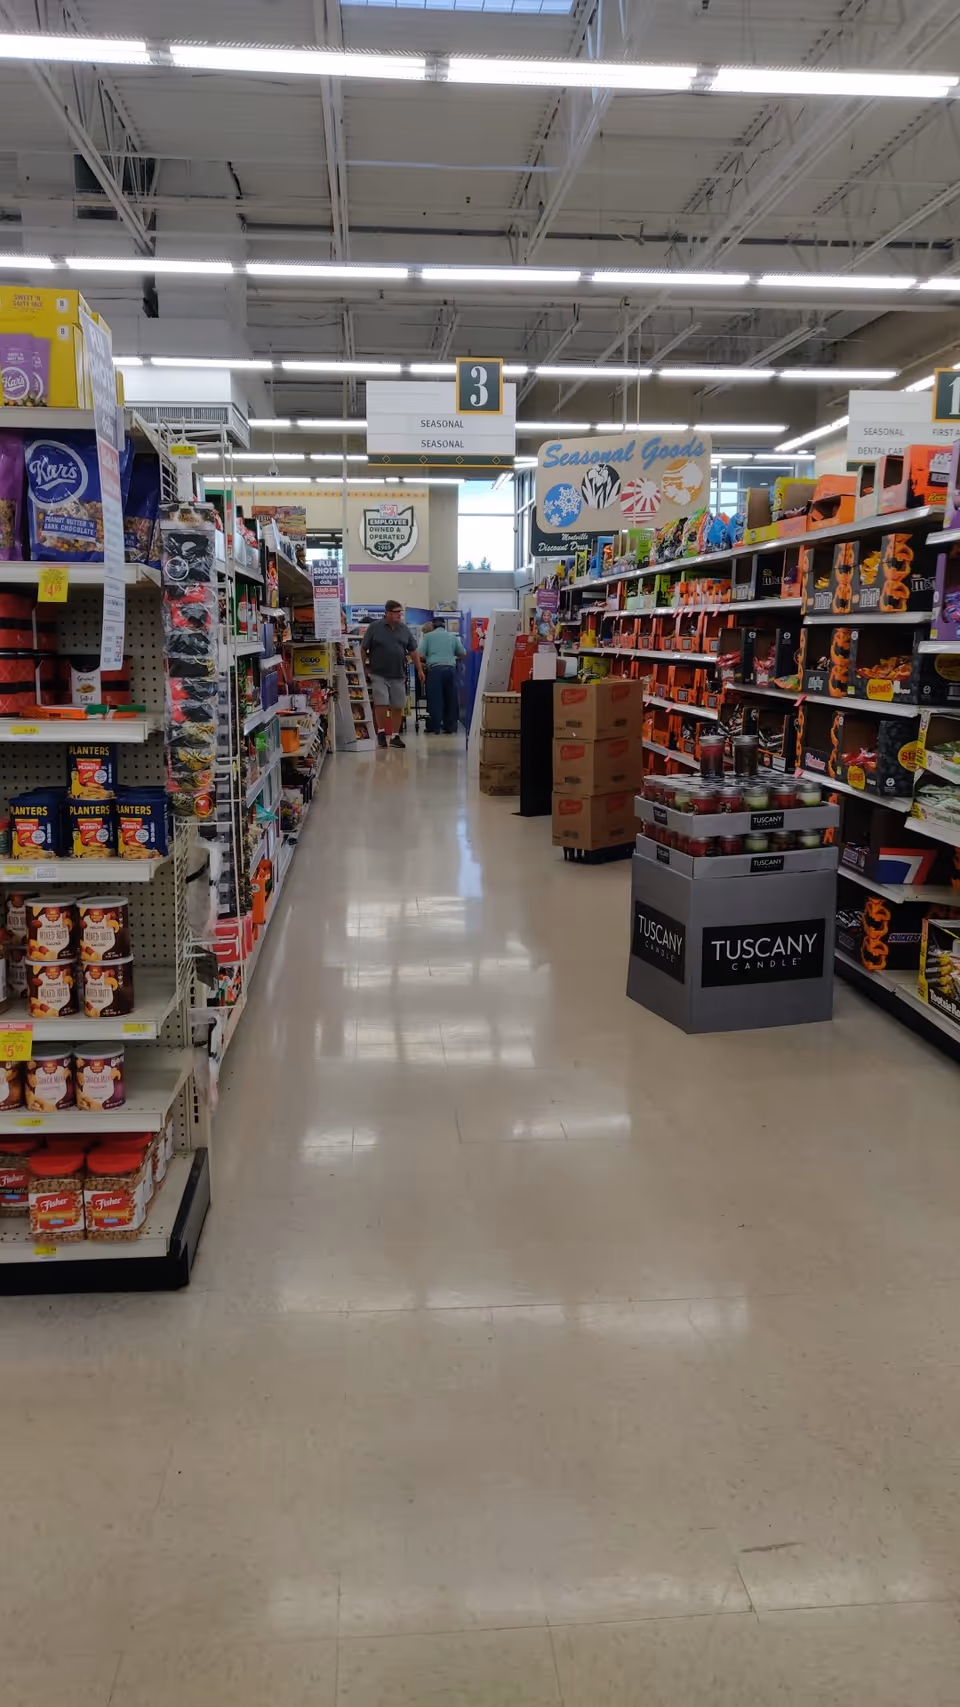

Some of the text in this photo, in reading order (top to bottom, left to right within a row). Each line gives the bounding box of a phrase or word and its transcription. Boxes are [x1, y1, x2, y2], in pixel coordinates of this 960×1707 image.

[470, 365, 489, 407] 3
[420, 419, 464, 428] SEASONAL
[863, 428, 904, 436] SEASONAL
[932, 428, 954, 437] FIRST
[420, 439, 464, 448] SEASONAL
[542, 435, 707, 470] Seasonal Goods
[857, 446, 886, 455] DENTAL
[29, 457, 77, 487] Kar's
[66, 517, 87, 527] BUTTER
[60, 524, 95, 536] CHOCOLATE
[561, 532, 588, 541] Montville
[538, 541, 588, 552] Discount Drug
[69, 745, 110, 756] PLANTERS
[69, 805, 110, 816] PLANTERS
[752, 815, 782, 824] TUSCANY
[752, 858, 782, 867] TUSCANY
[637, 914, 683, 956] TUSCANY
[644, 940, 675, 963] CANDLE
[711, 932, 818, 961] TUSCANY
[731, 957, 798, 971] CANDLE
[40, 1197, 69, 1213] Fisher
[95, 1197, 122, 1211] Fisher
